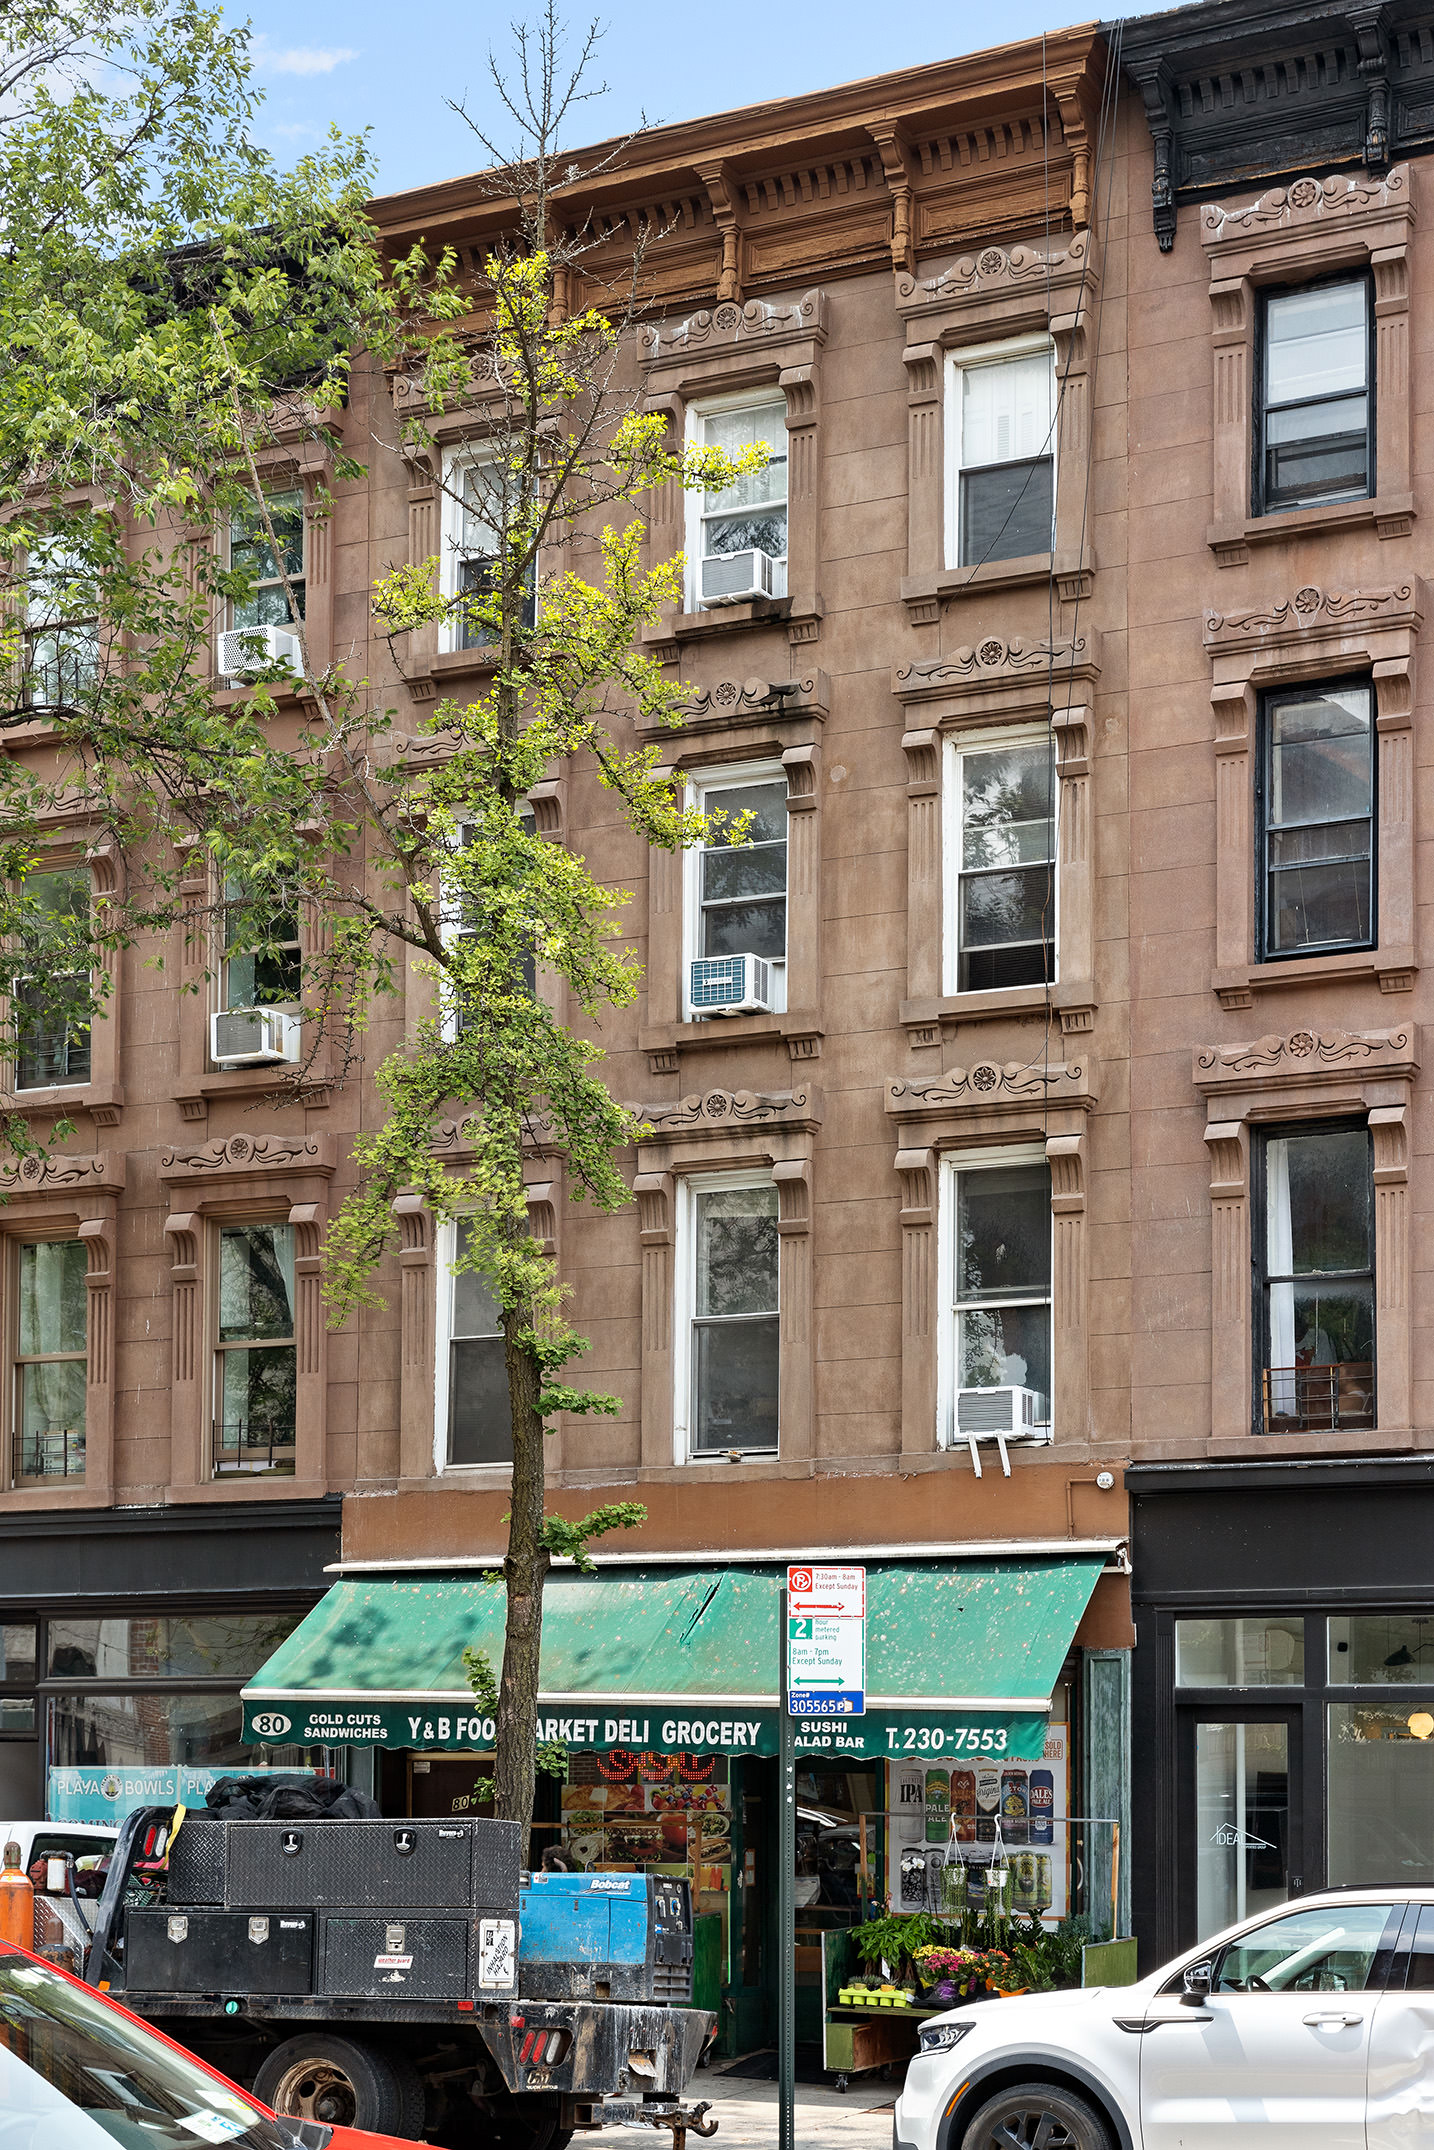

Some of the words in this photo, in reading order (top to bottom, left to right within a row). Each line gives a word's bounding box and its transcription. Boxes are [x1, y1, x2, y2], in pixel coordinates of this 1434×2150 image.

[815, 1583, 835, 1591] Except
[836, 1583, 858, 1591] Sunday
[795, 1618, 807, 1637] 2
[792, 1647, 807, 1655] 8am
[814, 1647, 829, 1656] 7pm
[792, 1657, 815, 1666] Except
[817, 1657, 842, 1666] Sunday
[791, 1700, 836, 1713] 305565
[259, 1715, 284, 1733] 80
[309, 1713, 343, 1725] GOLD
[347, 1714, 381, 1725] CUTS
[303, 1727, 388, 1739] SANDWICHES
[456, 1717, 496, 1741] FOO
[535, 1718, 599, 1742] ARKET
[604, 1719, 649, 1742] DELI
[661, 1720, 761, 1745] GROCERY
[800, 1721, 847, 1733] SUSHI
[794, 1736, 832, 1748] ALAD
[835, 1736, 865, 1748] BAR
[1044, 1741, 1062, 1750] SOLD
[1044, 1750, 1061, 1758] HERE
[57, 1780, 100, 1795] PLAYA
[125, 1780, 174, 1795] BOWLS
[187, 1780, 216, 1795] PLA
[900, 1784, 923, 1803] IPA
[453, 1796, 468, 1810] 80
[925, 1804, 950, 1813] PALE
[1216, 1826, 1247, 1845] IDEAL
[590, 1879, 631, 1890] Bobcat
